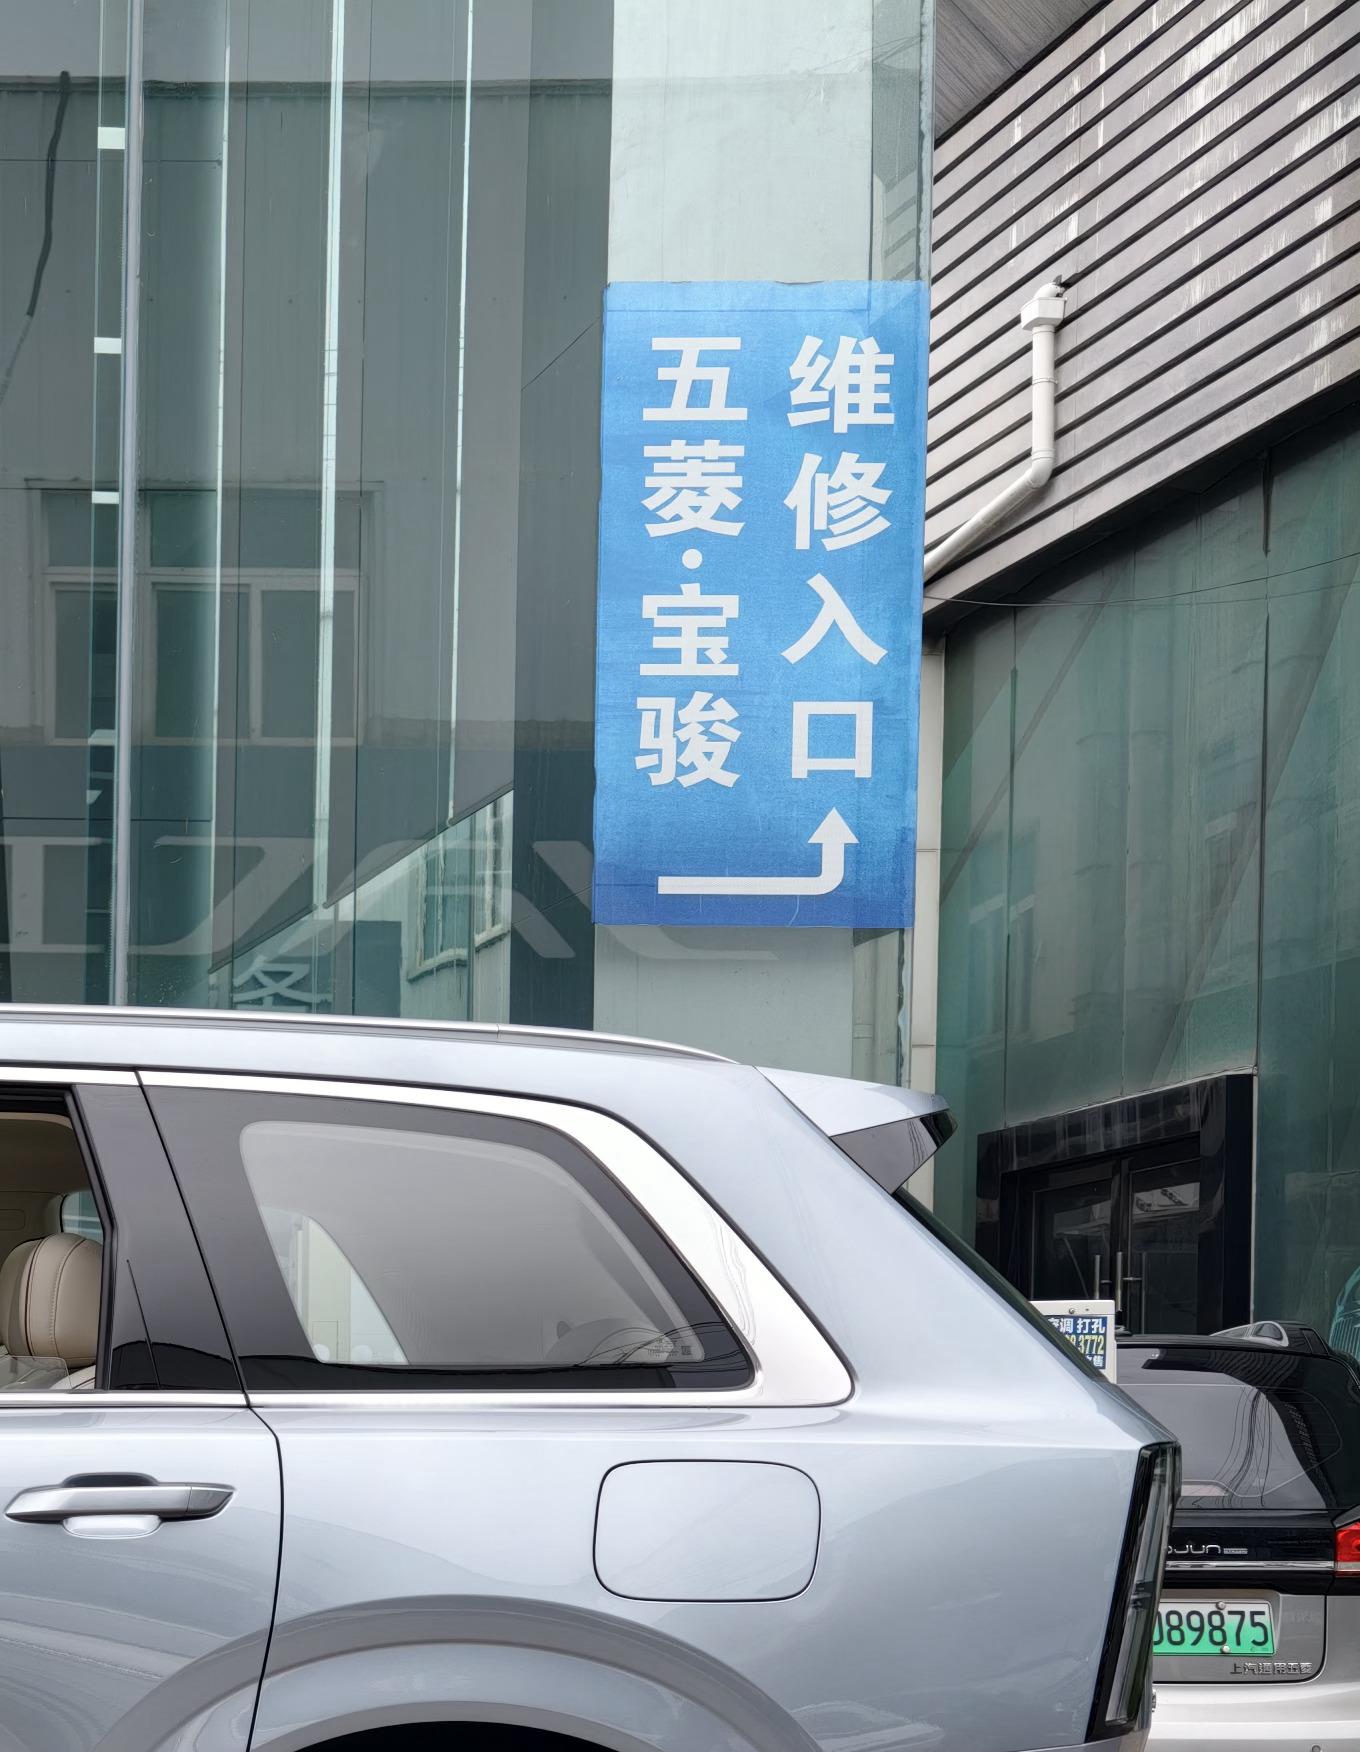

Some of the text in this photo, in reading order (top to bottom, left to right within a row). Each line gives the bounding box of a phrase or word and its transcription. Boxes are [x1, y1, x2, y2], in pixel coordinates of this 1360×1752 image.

[781, 334, 897, 780] 维修入口
[1076, 1317, 1106, 1334] 打孔
